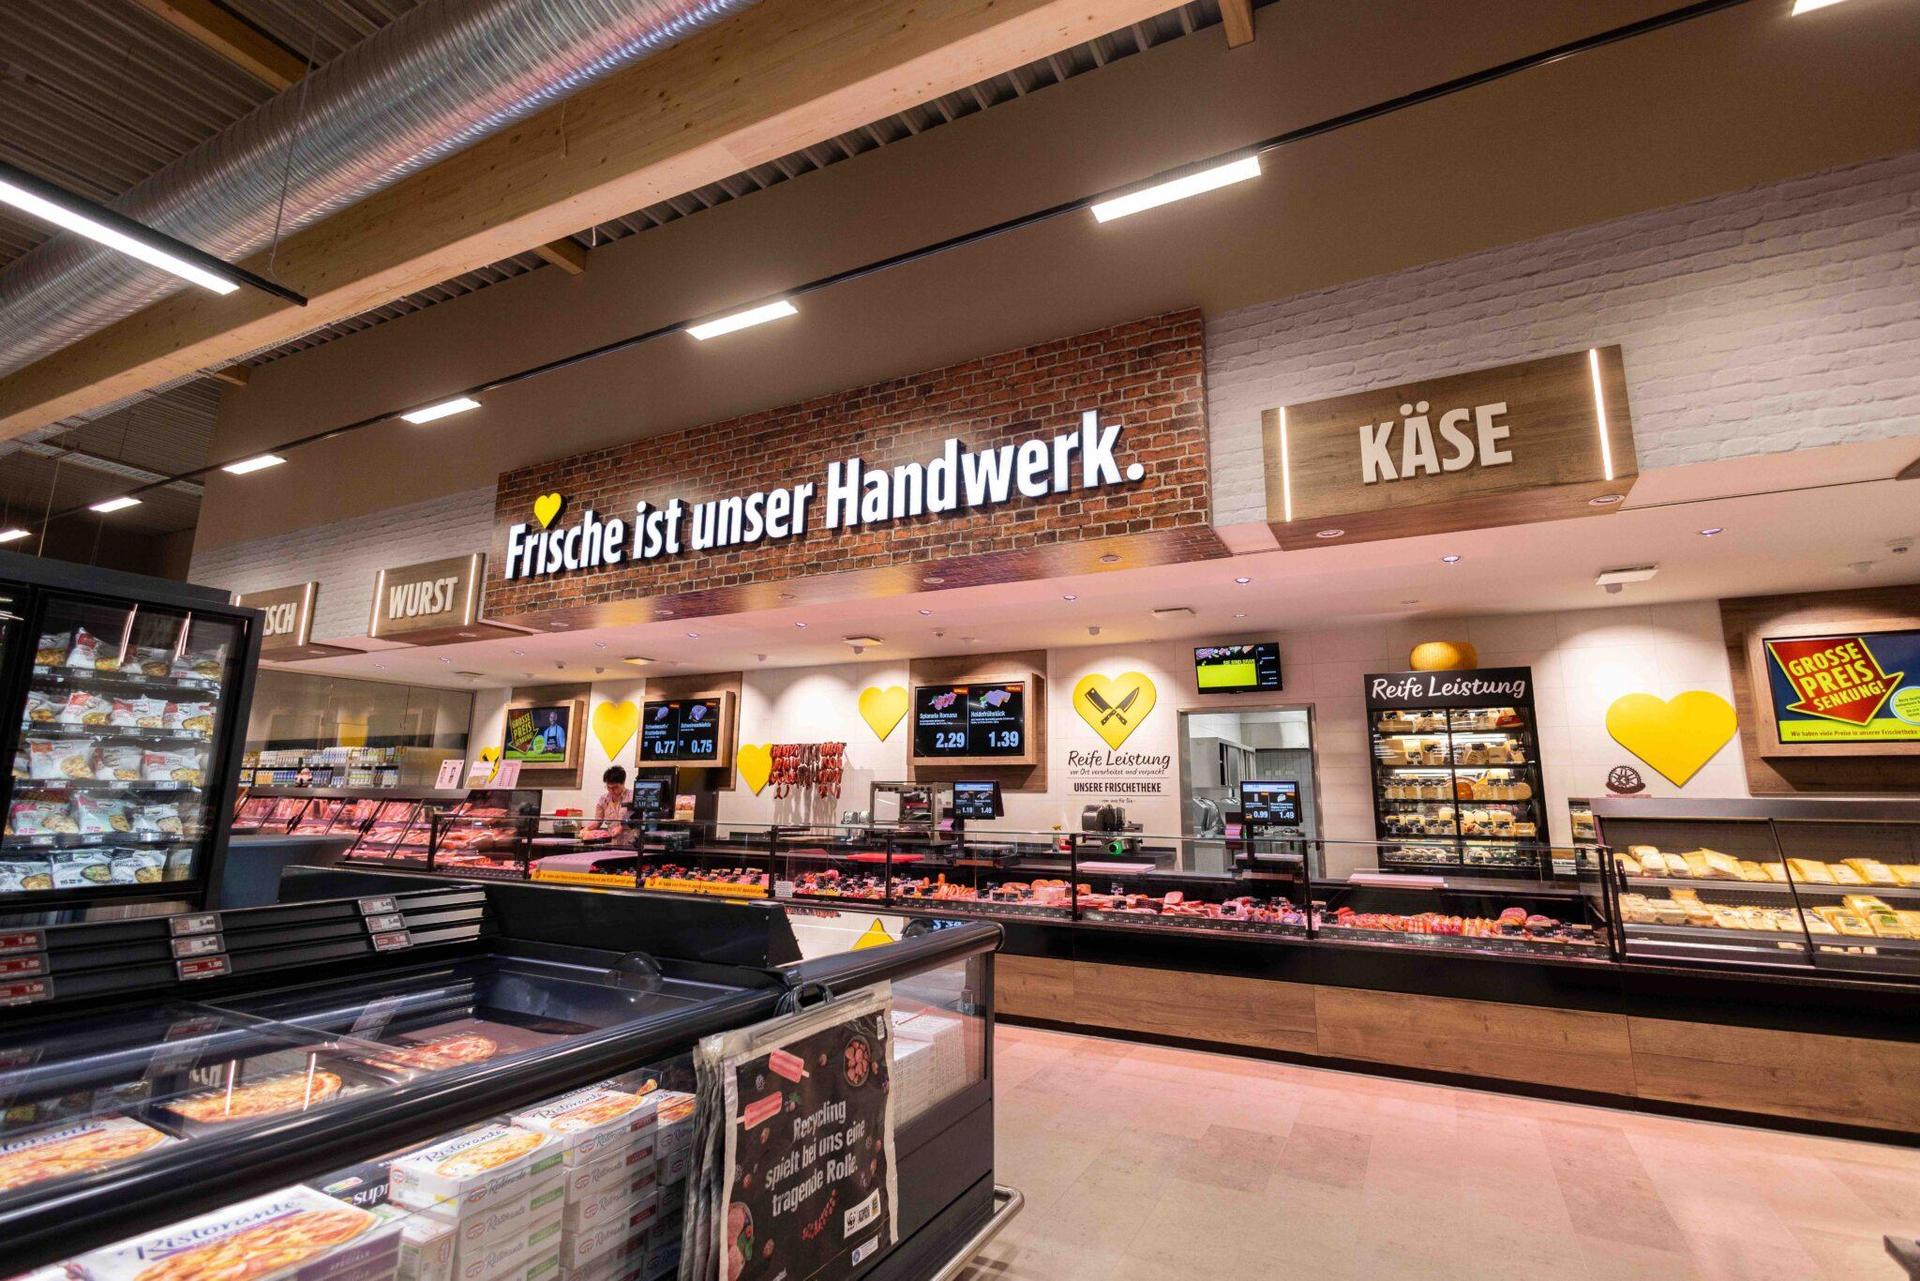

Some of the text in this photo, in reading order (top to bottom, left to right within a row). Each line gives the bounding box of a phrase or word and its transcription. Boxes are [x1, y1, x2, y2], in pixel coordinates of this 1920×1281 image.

[1359, 400, 1513, 484] KÄSE
[505, 410, 1145, 580] Frische ist unser Handwerk.
[389, 577, 459, 620] WURST
[1788, 642, 1863, 677] GROSSE
[1372, 676, 1526, 700] Reife Leistung
[1799, 659, 1875, 698] PREIS
[1813, 680, 1887, 711] SENKUNG!
[655, 740, 676, 754] 0.77
[691, 740, 712, 753] 0.75
[935, 732, 965, 748] 2.29
[988, 731, 1019, 747] 1.39
[1068, 750, 1171, 769] Reife Leistung
[1074, 783, 1162, 793] UNSERE FRISCHETHEKE
[793, 1100, 847, 1142] Recycling
[765, 1119, 866, 1191] spielt bei uns eine
[772, 1154, 859, 1217] tragende Rolle.
